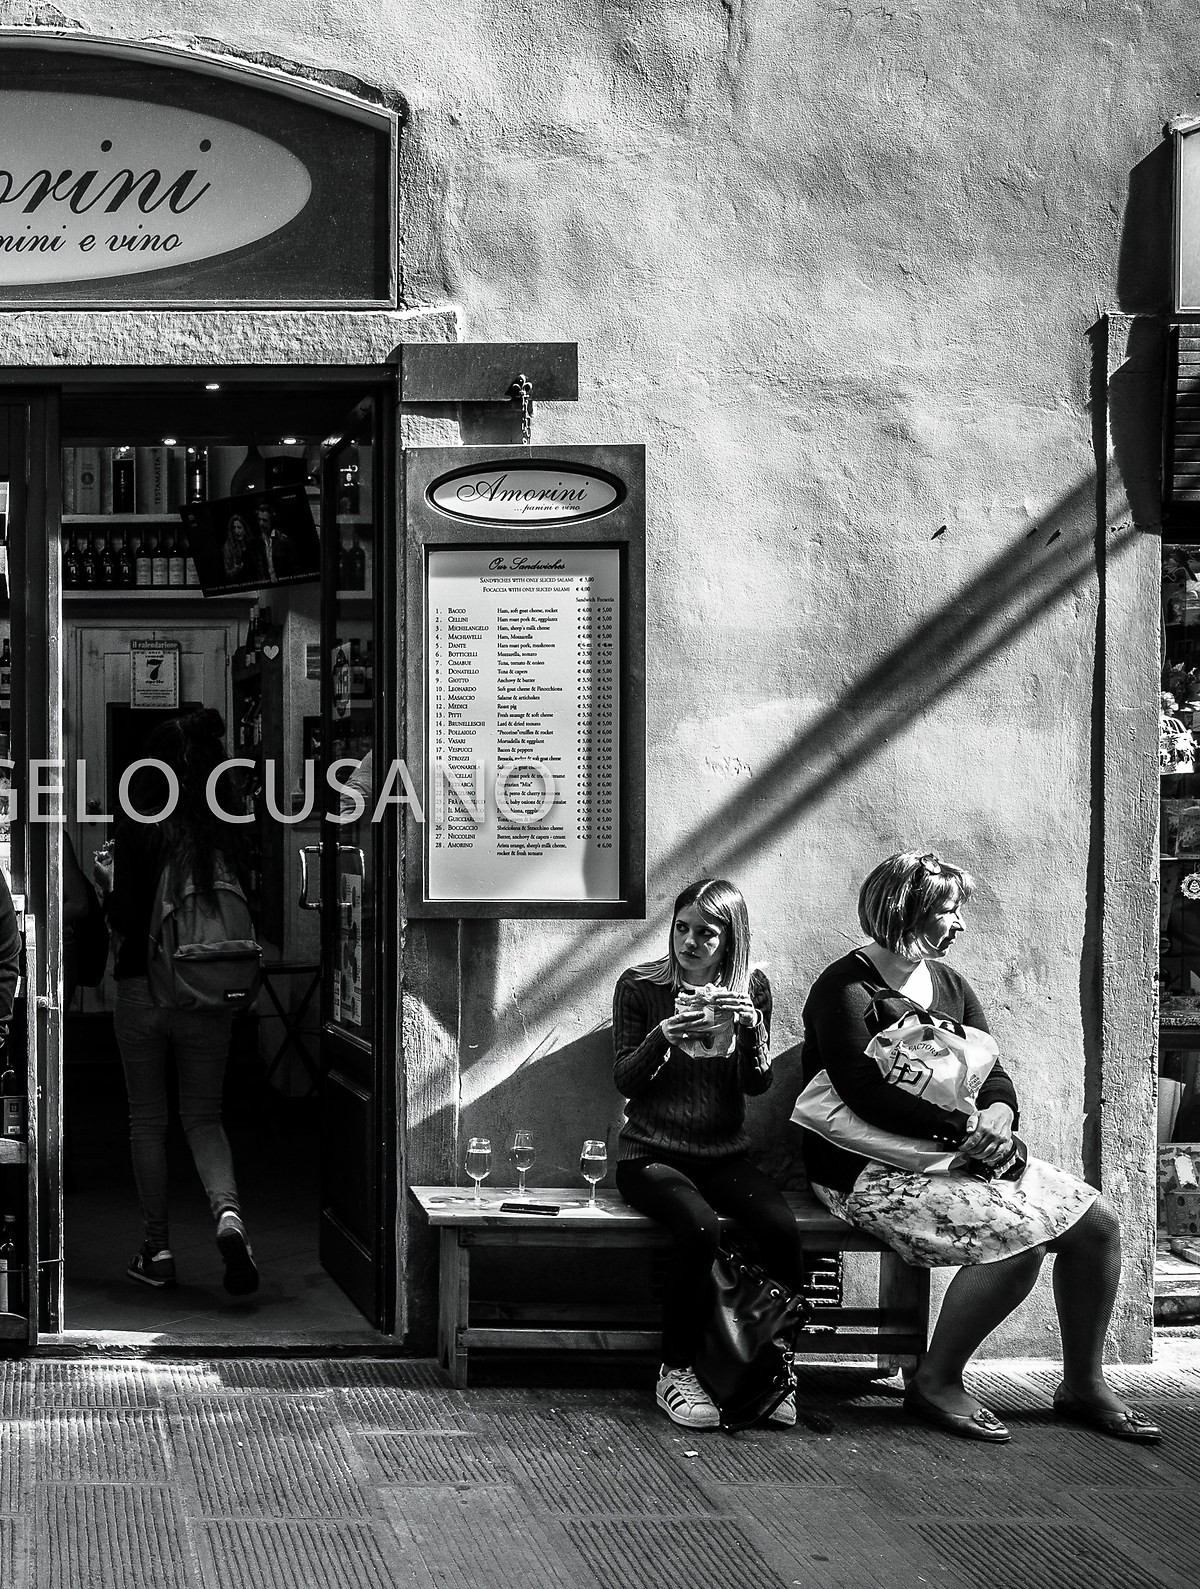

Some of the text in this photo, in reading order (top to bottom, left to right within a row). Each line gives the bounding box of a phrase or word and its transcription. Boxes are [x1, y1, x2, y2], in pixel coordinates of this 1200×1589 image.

[78, 234, 96, 252] e
[104, 224, 183, 252] vino
[456, 474, 589, 502] Amorini
[488, 557, 565, 570] Our Sandwiches
[146, 659, 164, 680] 7
